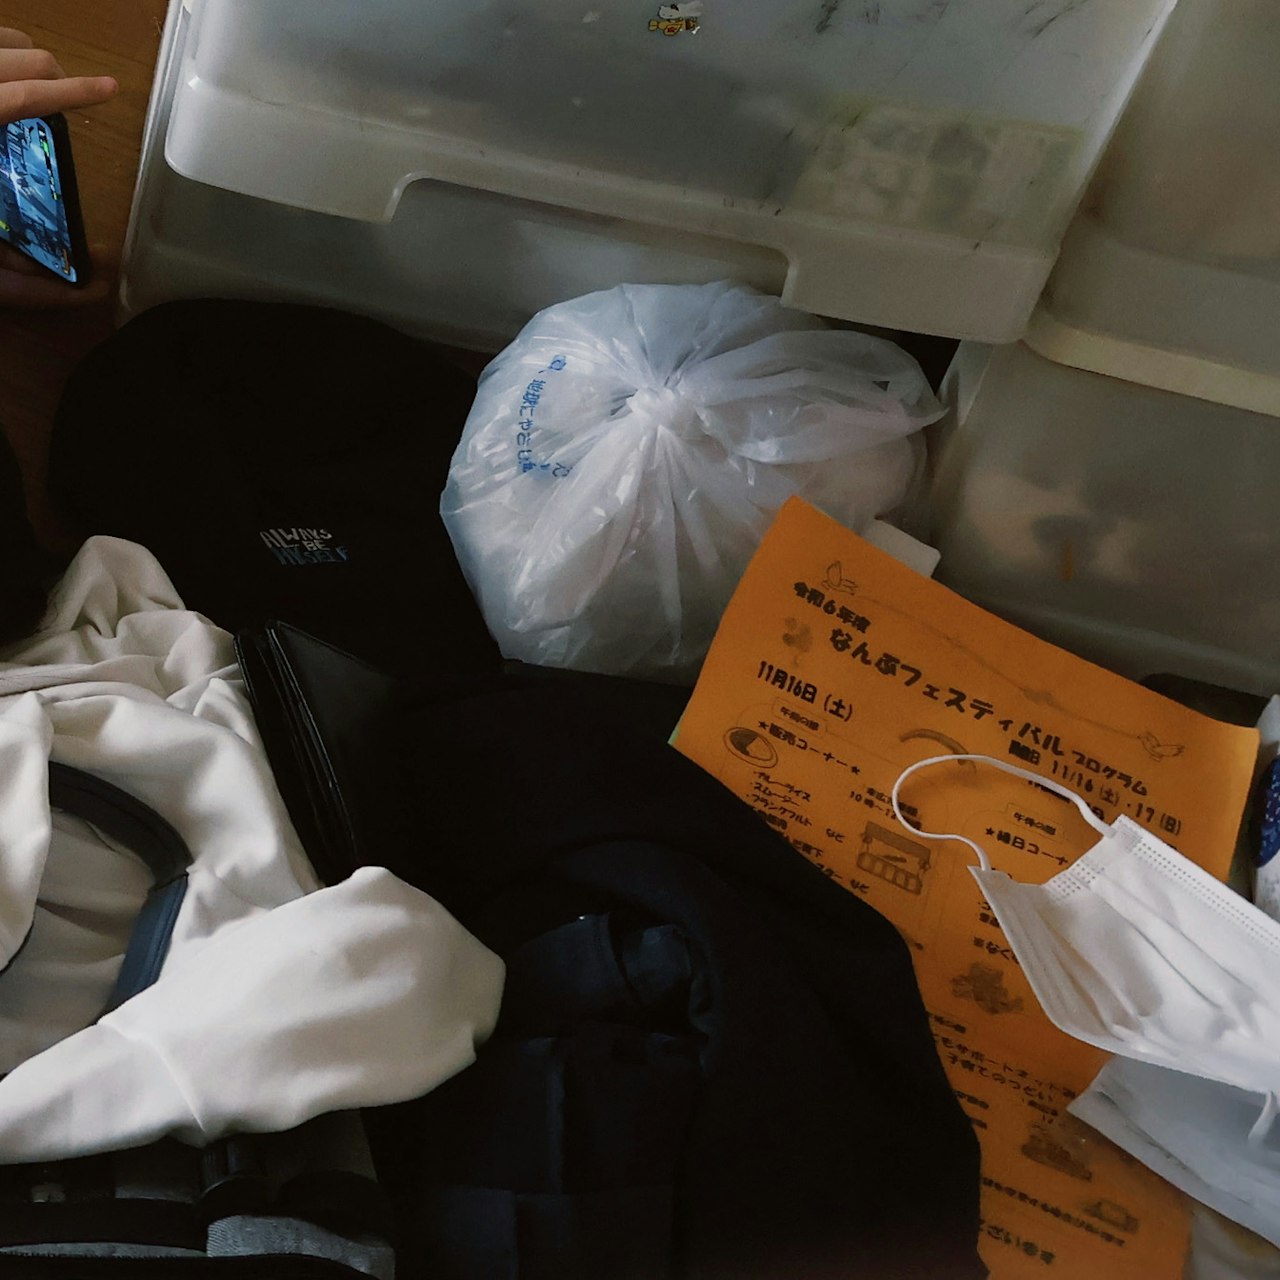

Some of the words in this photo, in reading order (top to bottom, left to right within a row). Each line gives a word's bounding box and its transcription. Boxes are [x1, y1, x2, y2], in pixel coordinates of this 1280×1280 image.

[302, 539, 331, 551] BE
[793, 581, 871, 633] 令和6年度
[829, 628, 1065, 756] なんぶフェスティバル
[1072, 750, 1148, 796] プログラム
